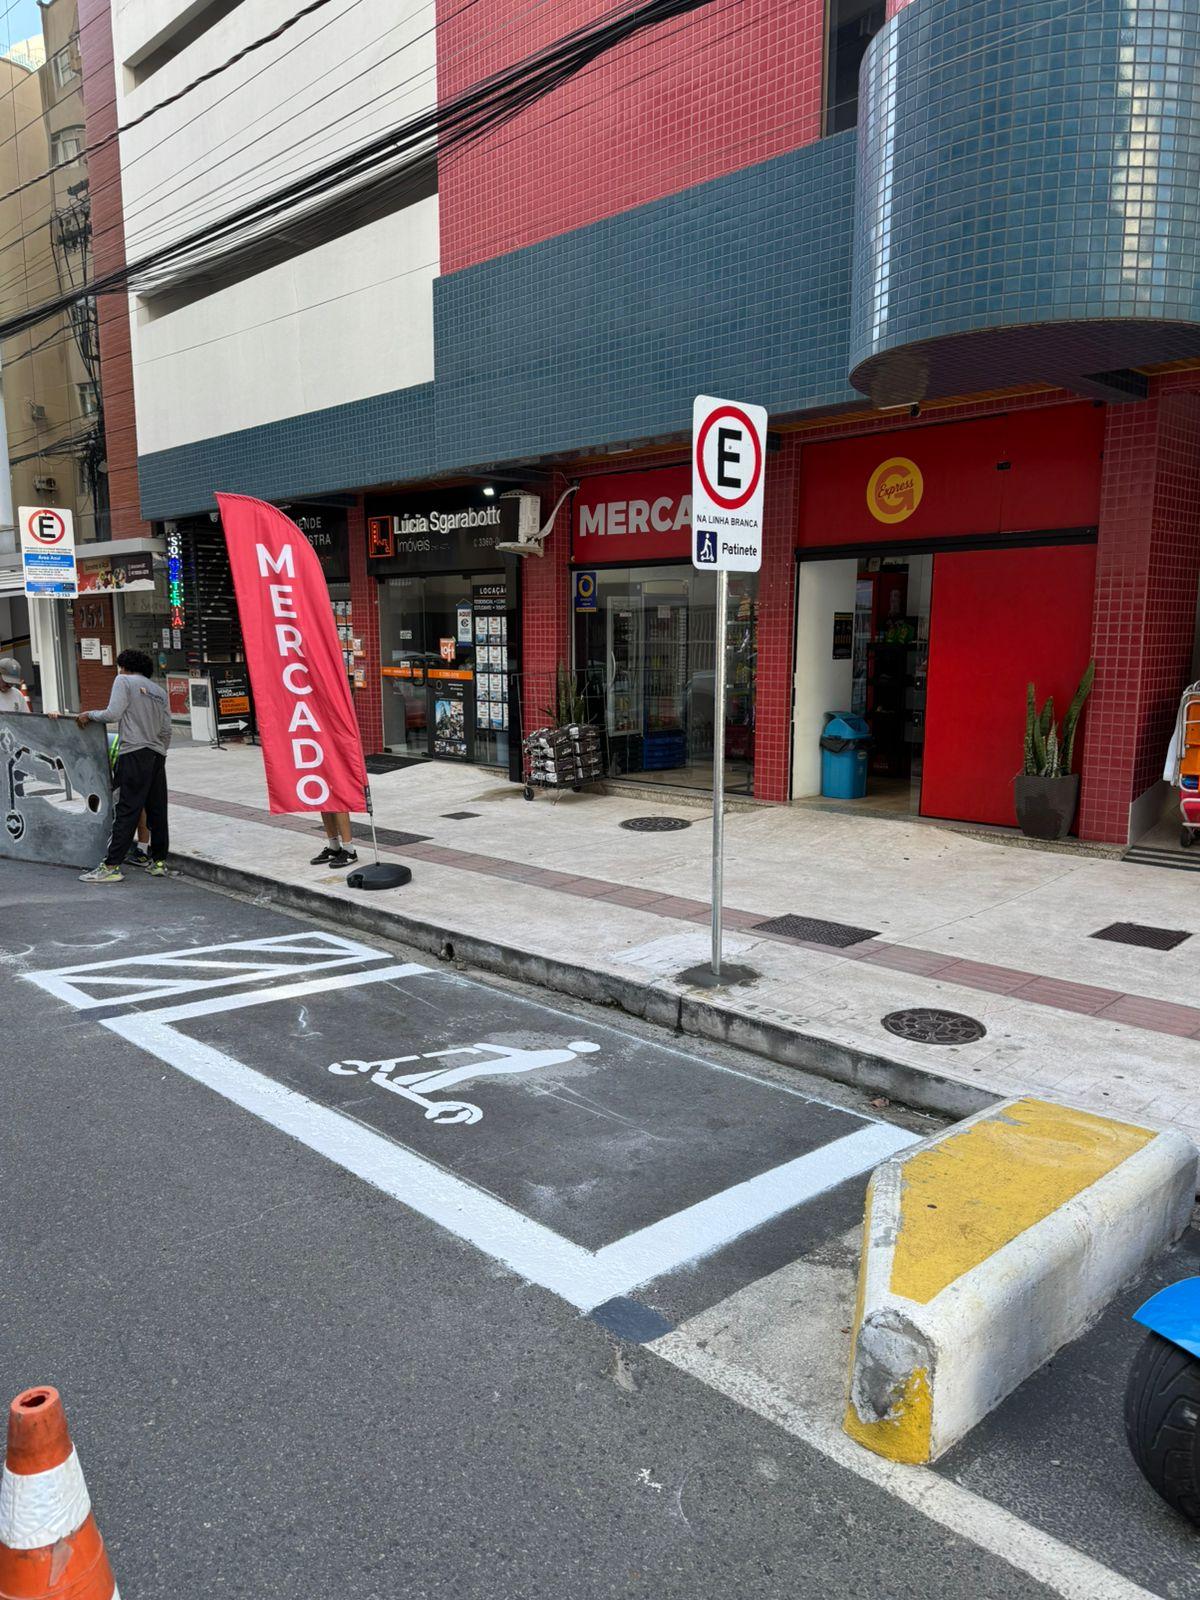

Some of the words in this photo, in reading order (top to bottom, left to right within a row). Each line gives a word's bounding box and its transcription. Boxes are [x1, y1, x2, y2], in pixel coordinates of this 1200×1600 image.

[717, 427, 743, 489] E
[877, 478, 914, 499] Express
[38, 515, 56, 539] E
[393, 513, 429, 535] Lúcia
[696, 514, 707, 523] NA
[708, 515, 730, 525] LINHA
[730, 517, 758, 528] BRANCA
[307, 533, 332, 546] STRA
[721, 542, 758, 556] Patinete
[479, 585, 507, 596] LOCAÇÃ
[255, 543, 331, 806] MERCADO
